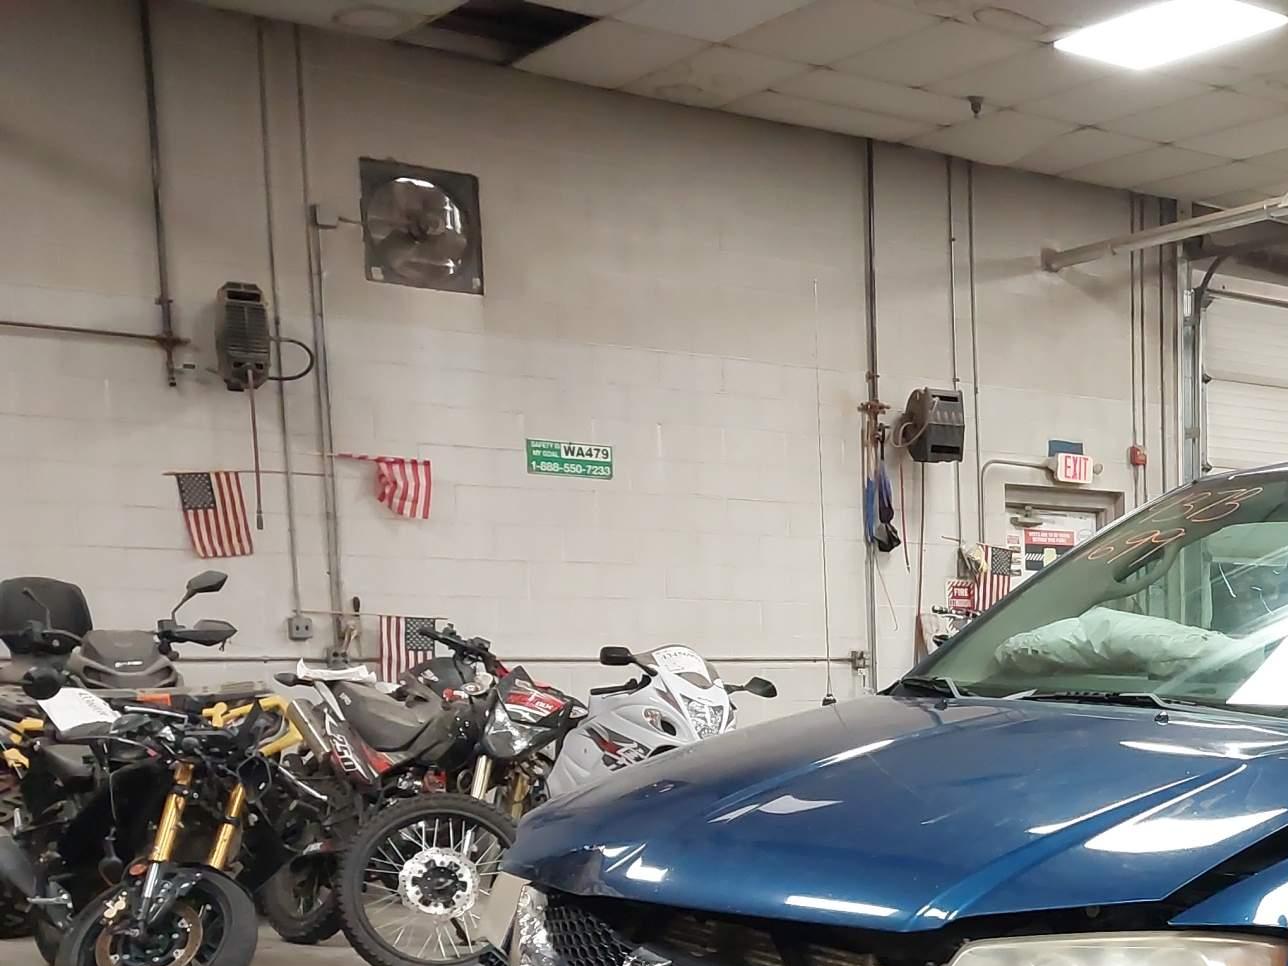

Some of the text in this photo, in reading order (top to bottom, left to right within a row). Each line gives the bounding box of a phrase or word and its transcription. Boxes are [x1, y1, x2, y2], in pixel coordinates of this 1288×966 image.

[563, 446, 609, 460] WA479
[531, 460, 611, 476] 1-888-550-7233
[1064, 455, 1089, 480] EXIT
[953, 587, 969, 597] FIRE
